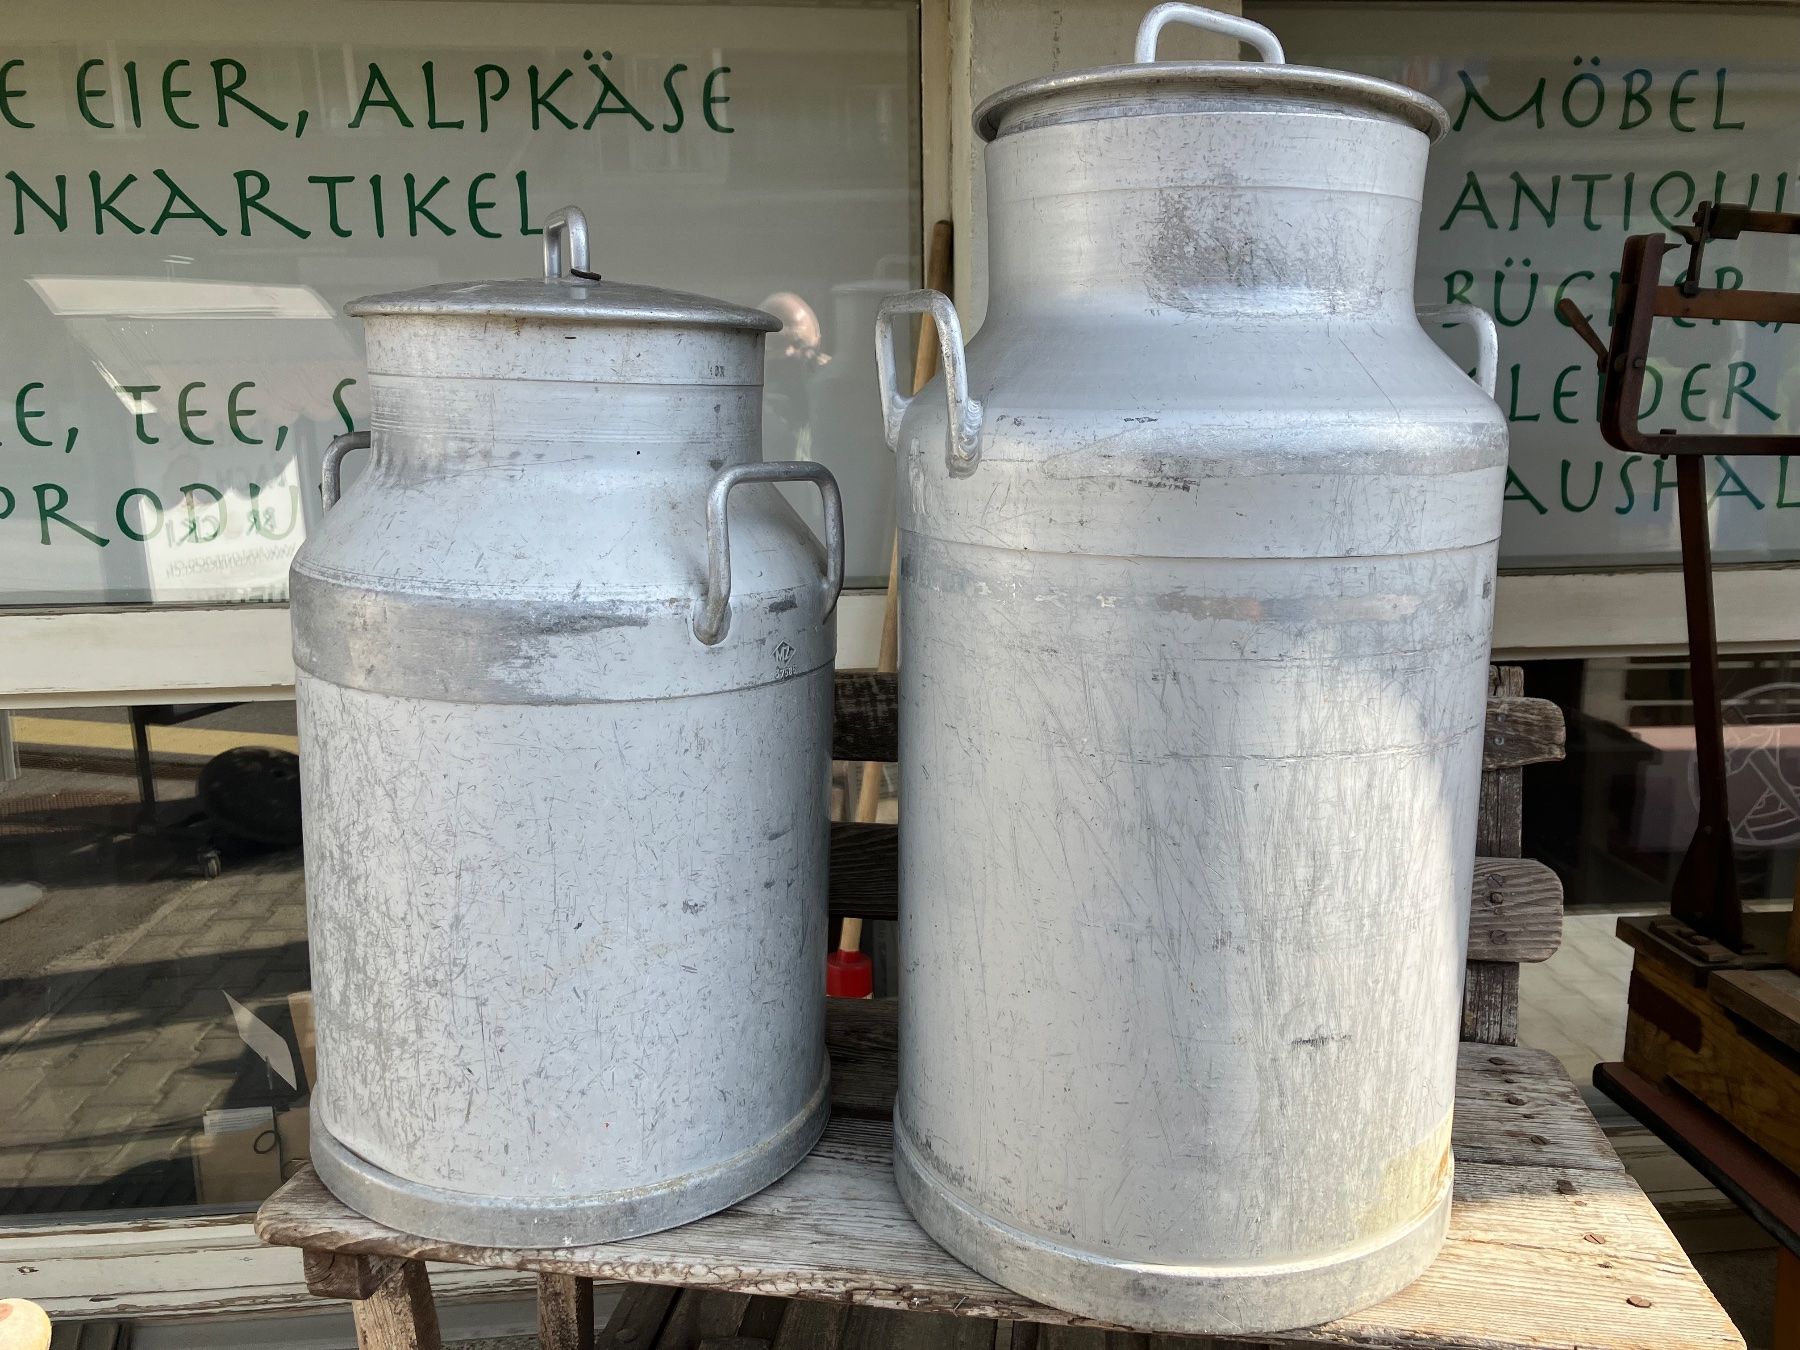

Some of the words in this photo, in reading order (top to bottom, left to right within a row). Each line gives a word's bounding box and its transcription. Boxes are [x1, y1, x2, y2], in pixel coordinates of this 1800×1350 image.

[76, 58, 309, 138] EIER,
[348, 49, 735, 133] ALPKÄSE
[1452, 56, 1746, 132] MÖBEL
[5, 168, 544, 240] NKARTIKEL
[1439, 170, 1800, 244] ANTIQUI
[0, 382, 79, 453] E,
[113, 381, 289, 451] TEE,
